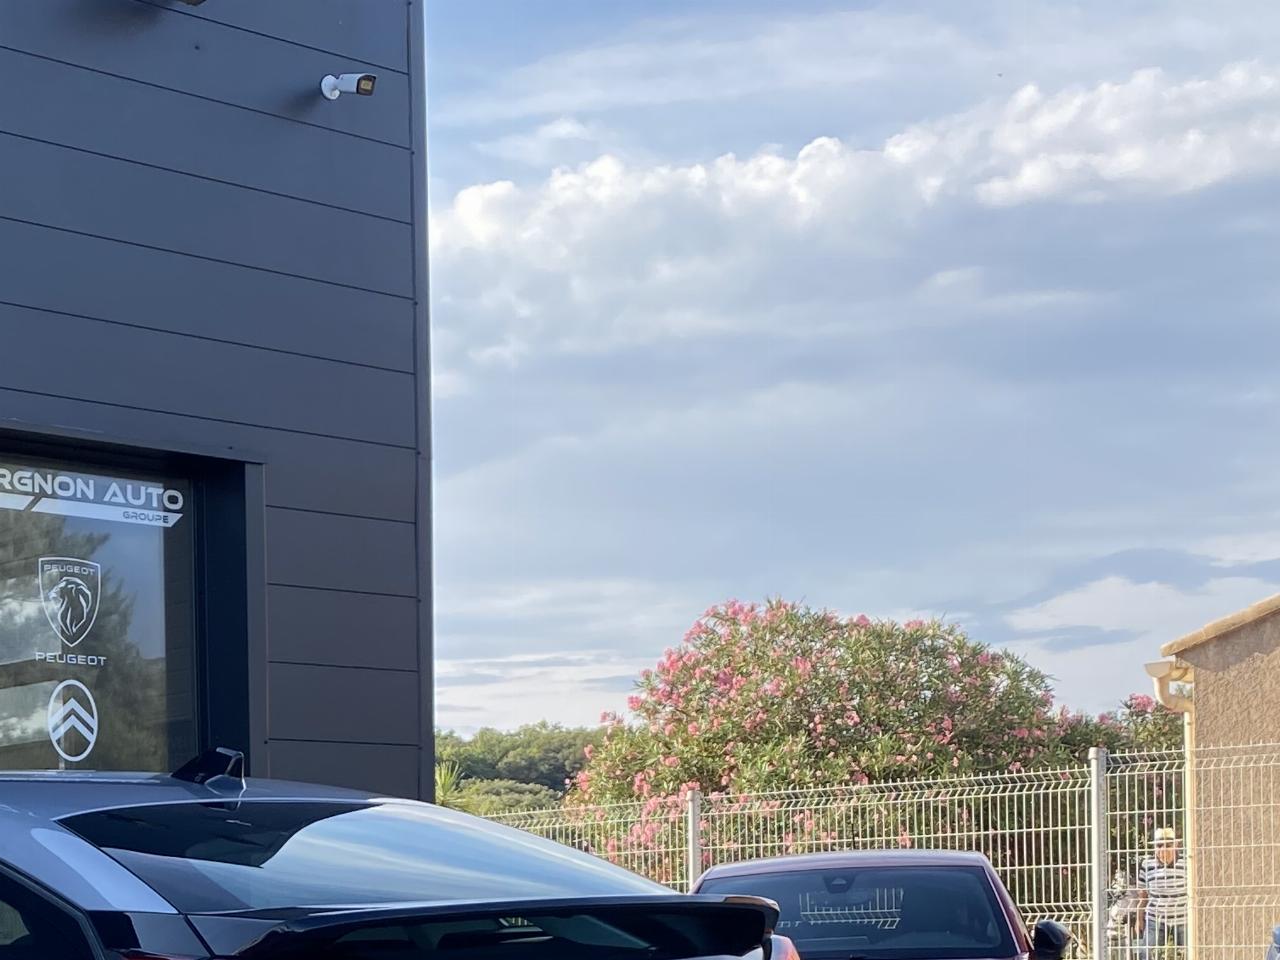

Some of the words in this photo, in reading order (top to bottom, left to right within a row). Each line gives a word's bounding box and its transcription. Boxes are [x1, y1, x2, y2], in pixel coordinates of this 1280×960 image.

[104, 482, 184, 510] AUTO
[122, 510, 169, 524] GROUPE
[42, 563, 96, 577] PEUGEOT
[35, 651, 107, 667] PEUGEOT
